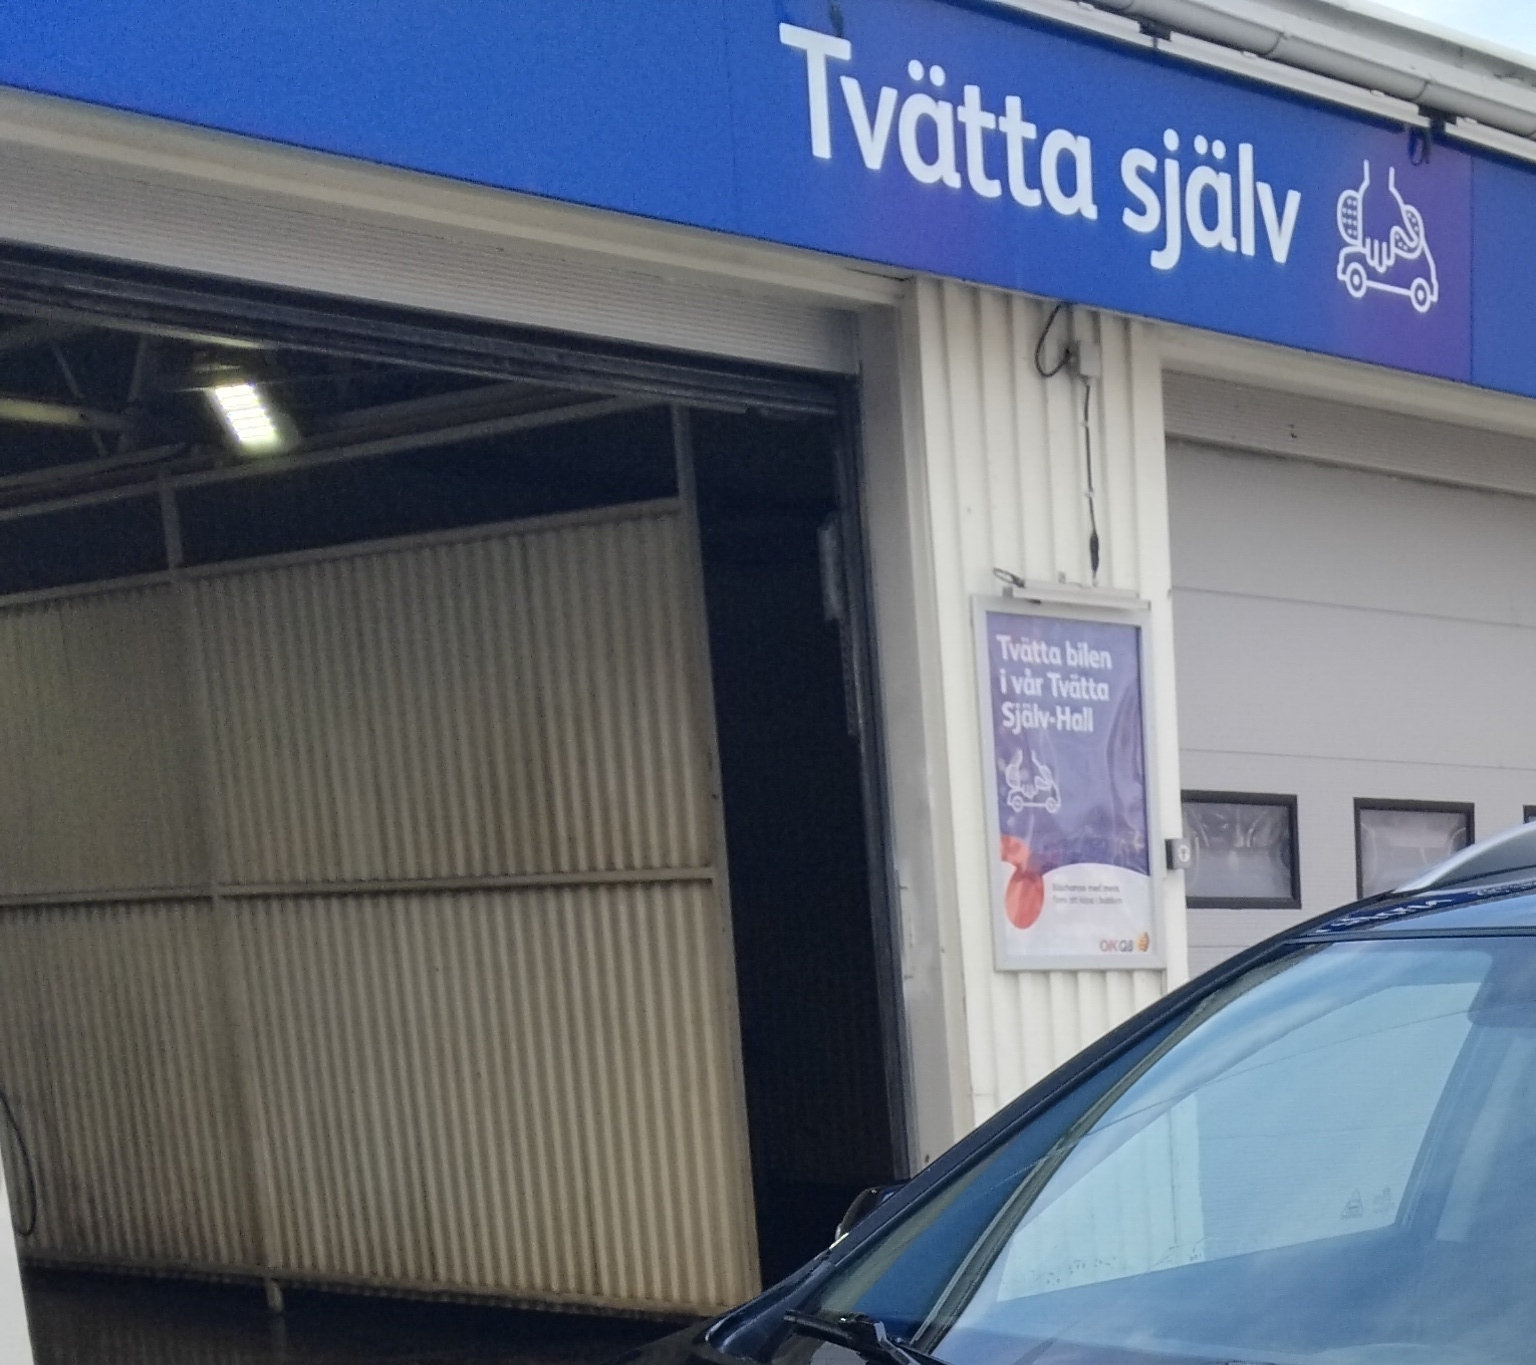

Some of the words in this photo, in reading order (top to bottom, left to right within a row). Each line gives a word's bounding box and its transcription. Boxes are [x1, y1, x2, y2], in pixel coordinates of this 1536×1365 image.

[779, 22, 1098, 220] Tvätta
[1120, 128, 1302, 271] själv
[995, 633, 1062, 666] Tvätta
[1065, 640, 1113, 670] bilen
[1000, 667, 1008, 696] i
[1010, 667, 1044, 697] vår
[1046, 671, 1110, 701] Tvätta
[1001, 701, 1094, 736] Själv-Hall
